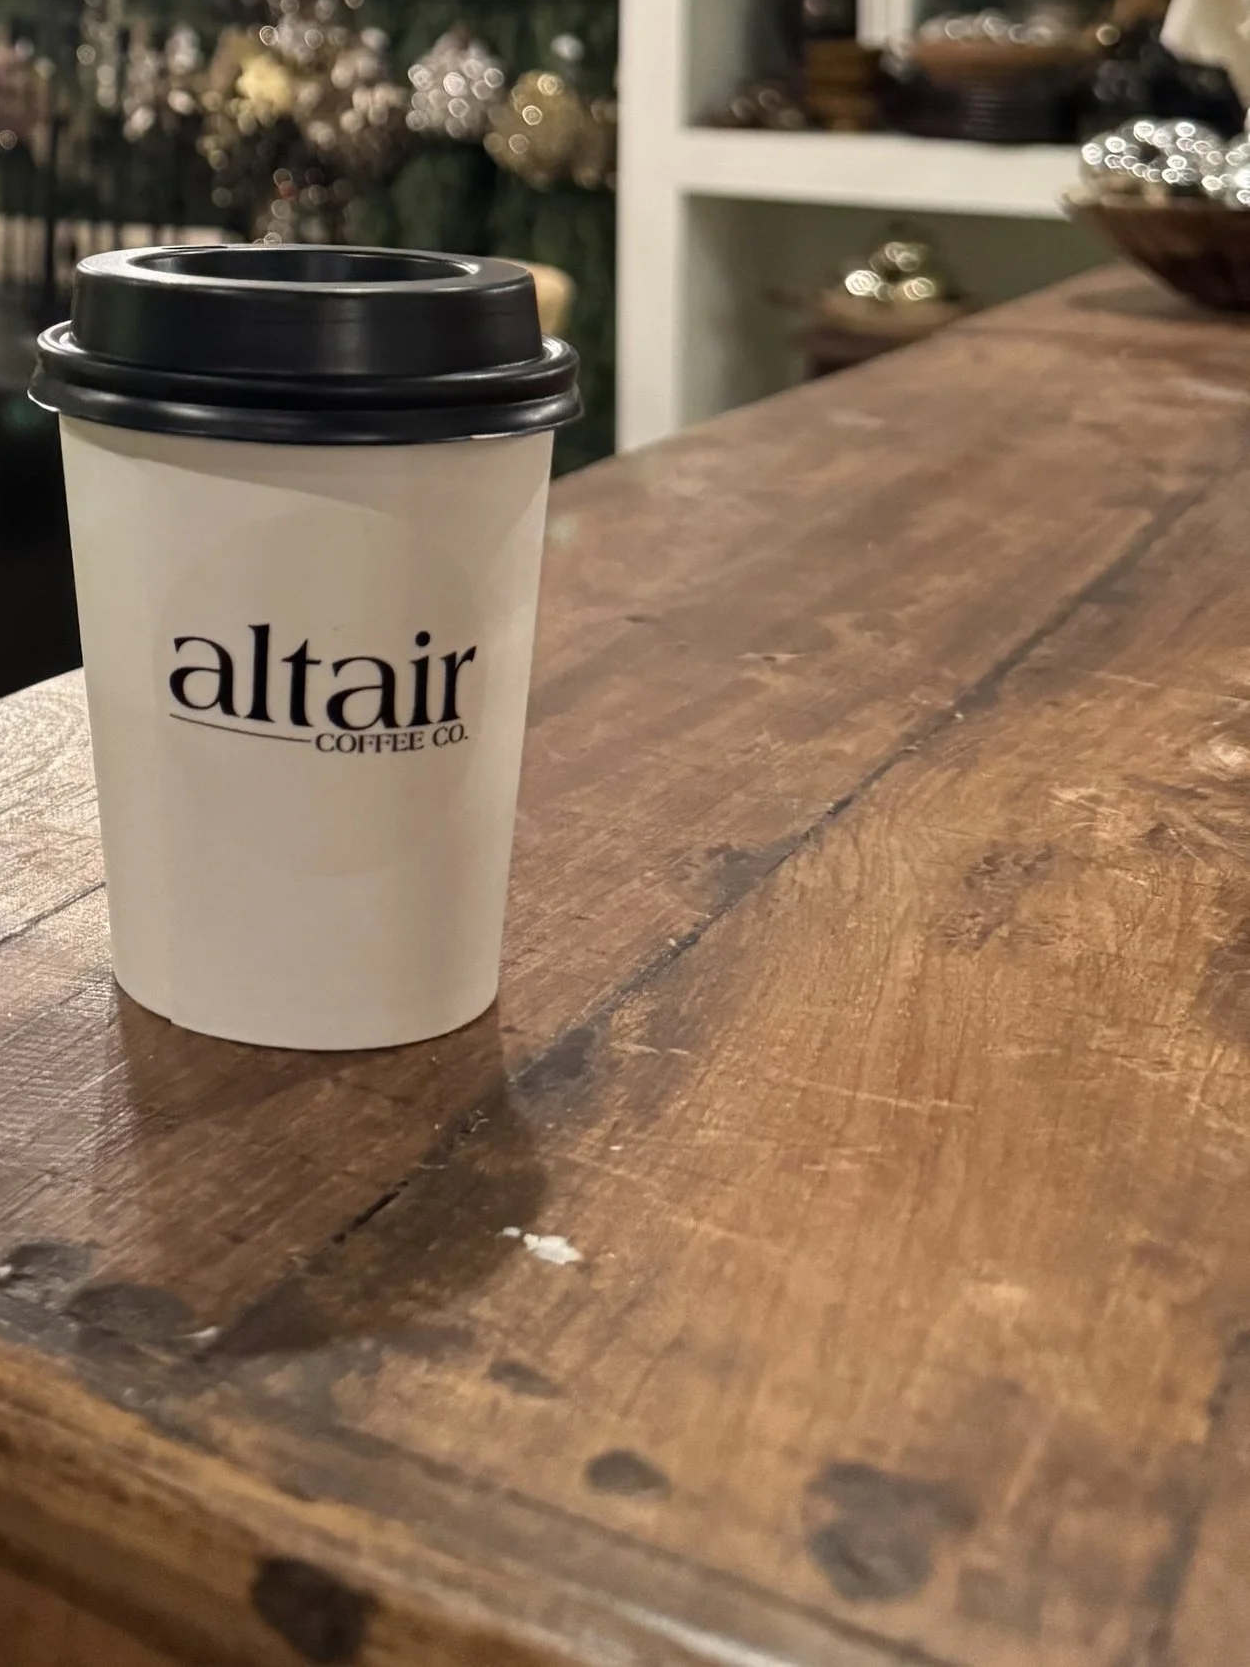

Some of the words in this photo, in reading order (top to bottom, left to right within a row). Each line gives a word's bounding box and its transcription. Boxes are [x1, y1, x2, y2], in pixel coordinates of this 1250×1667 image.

[169, 623, 478, 732] altair
[314, 732, 425, 754] COFFEE
[432, 723, 469, 748] CO.
